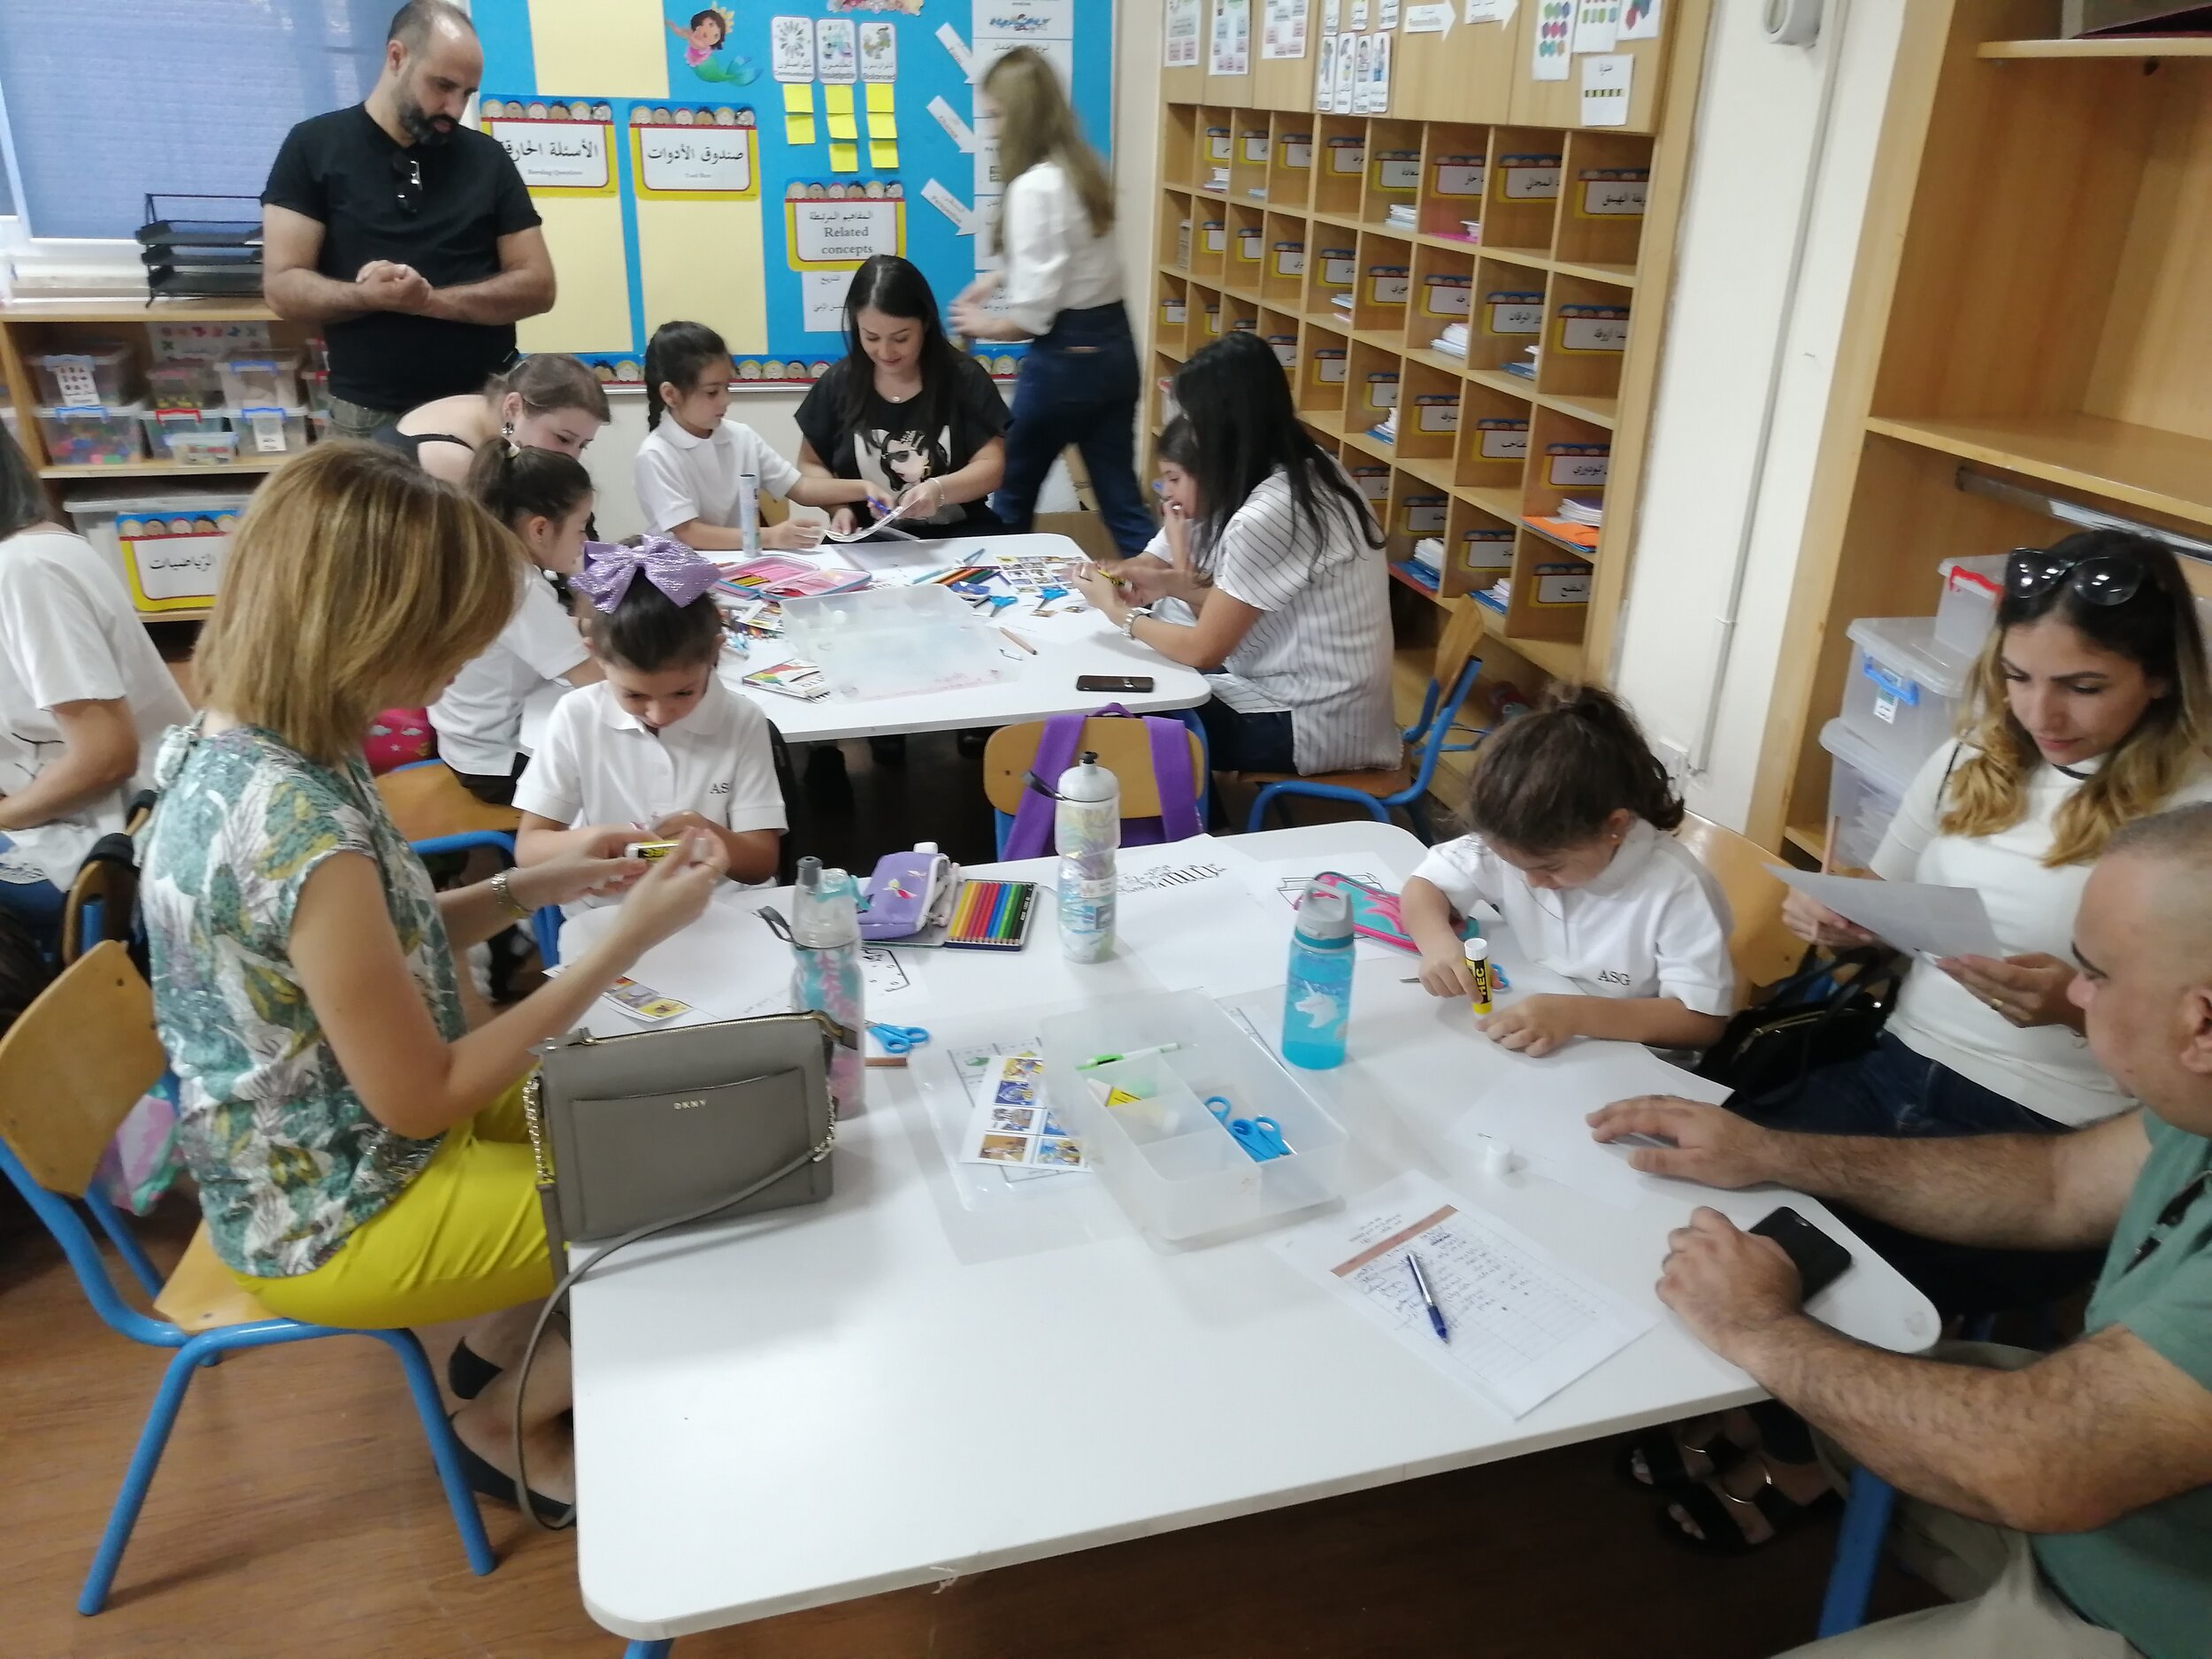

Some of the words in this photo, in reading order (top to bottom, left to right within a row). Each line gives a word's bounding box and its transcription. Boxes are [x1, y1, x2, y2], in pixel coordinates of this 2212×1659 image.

[648, 143, 695, 164] الأدوات
[700, 146, 744, 165] صندوق
[824, 227, 869, 237] Related
[821, 245, 873, 257] concepts
[1597, 970, 1632, 986] ASG
[673, 1100, 707, 1110] DKNY
